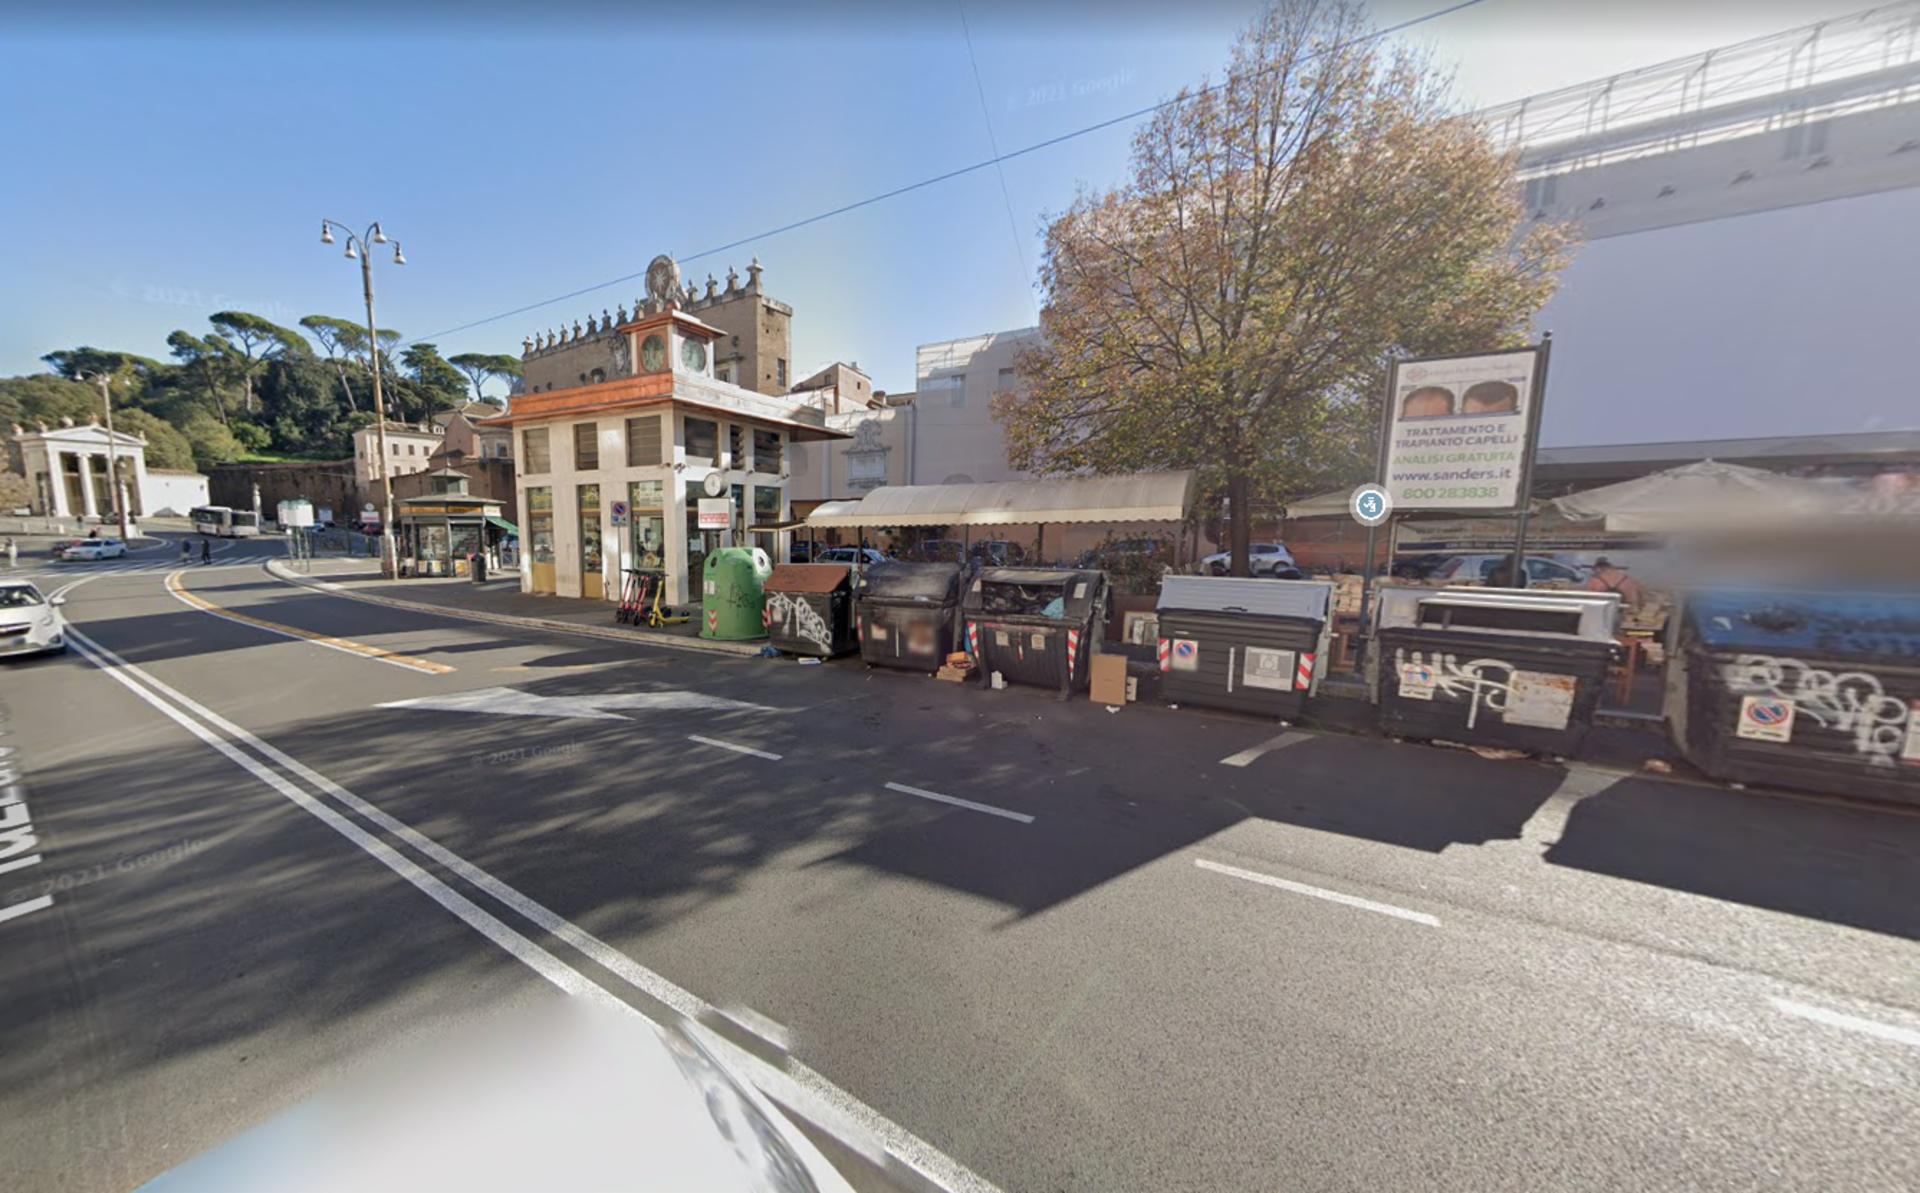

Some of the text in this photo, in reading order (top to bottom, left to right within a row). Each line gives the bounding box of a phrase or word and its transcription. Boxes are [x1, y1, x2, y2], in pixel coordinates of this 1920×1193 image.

[1406, 424, 1506, 437] TRATTAMENTO E
[1395, 434, 1518, 449] TRAPIANTO CAPELLI
[1392, 451, 1514, 465] ANALISI GRATUITA
[1392, 467, 1512, 481] www.sanders.it
[1402, 486, 1499, 499] 800 283838
